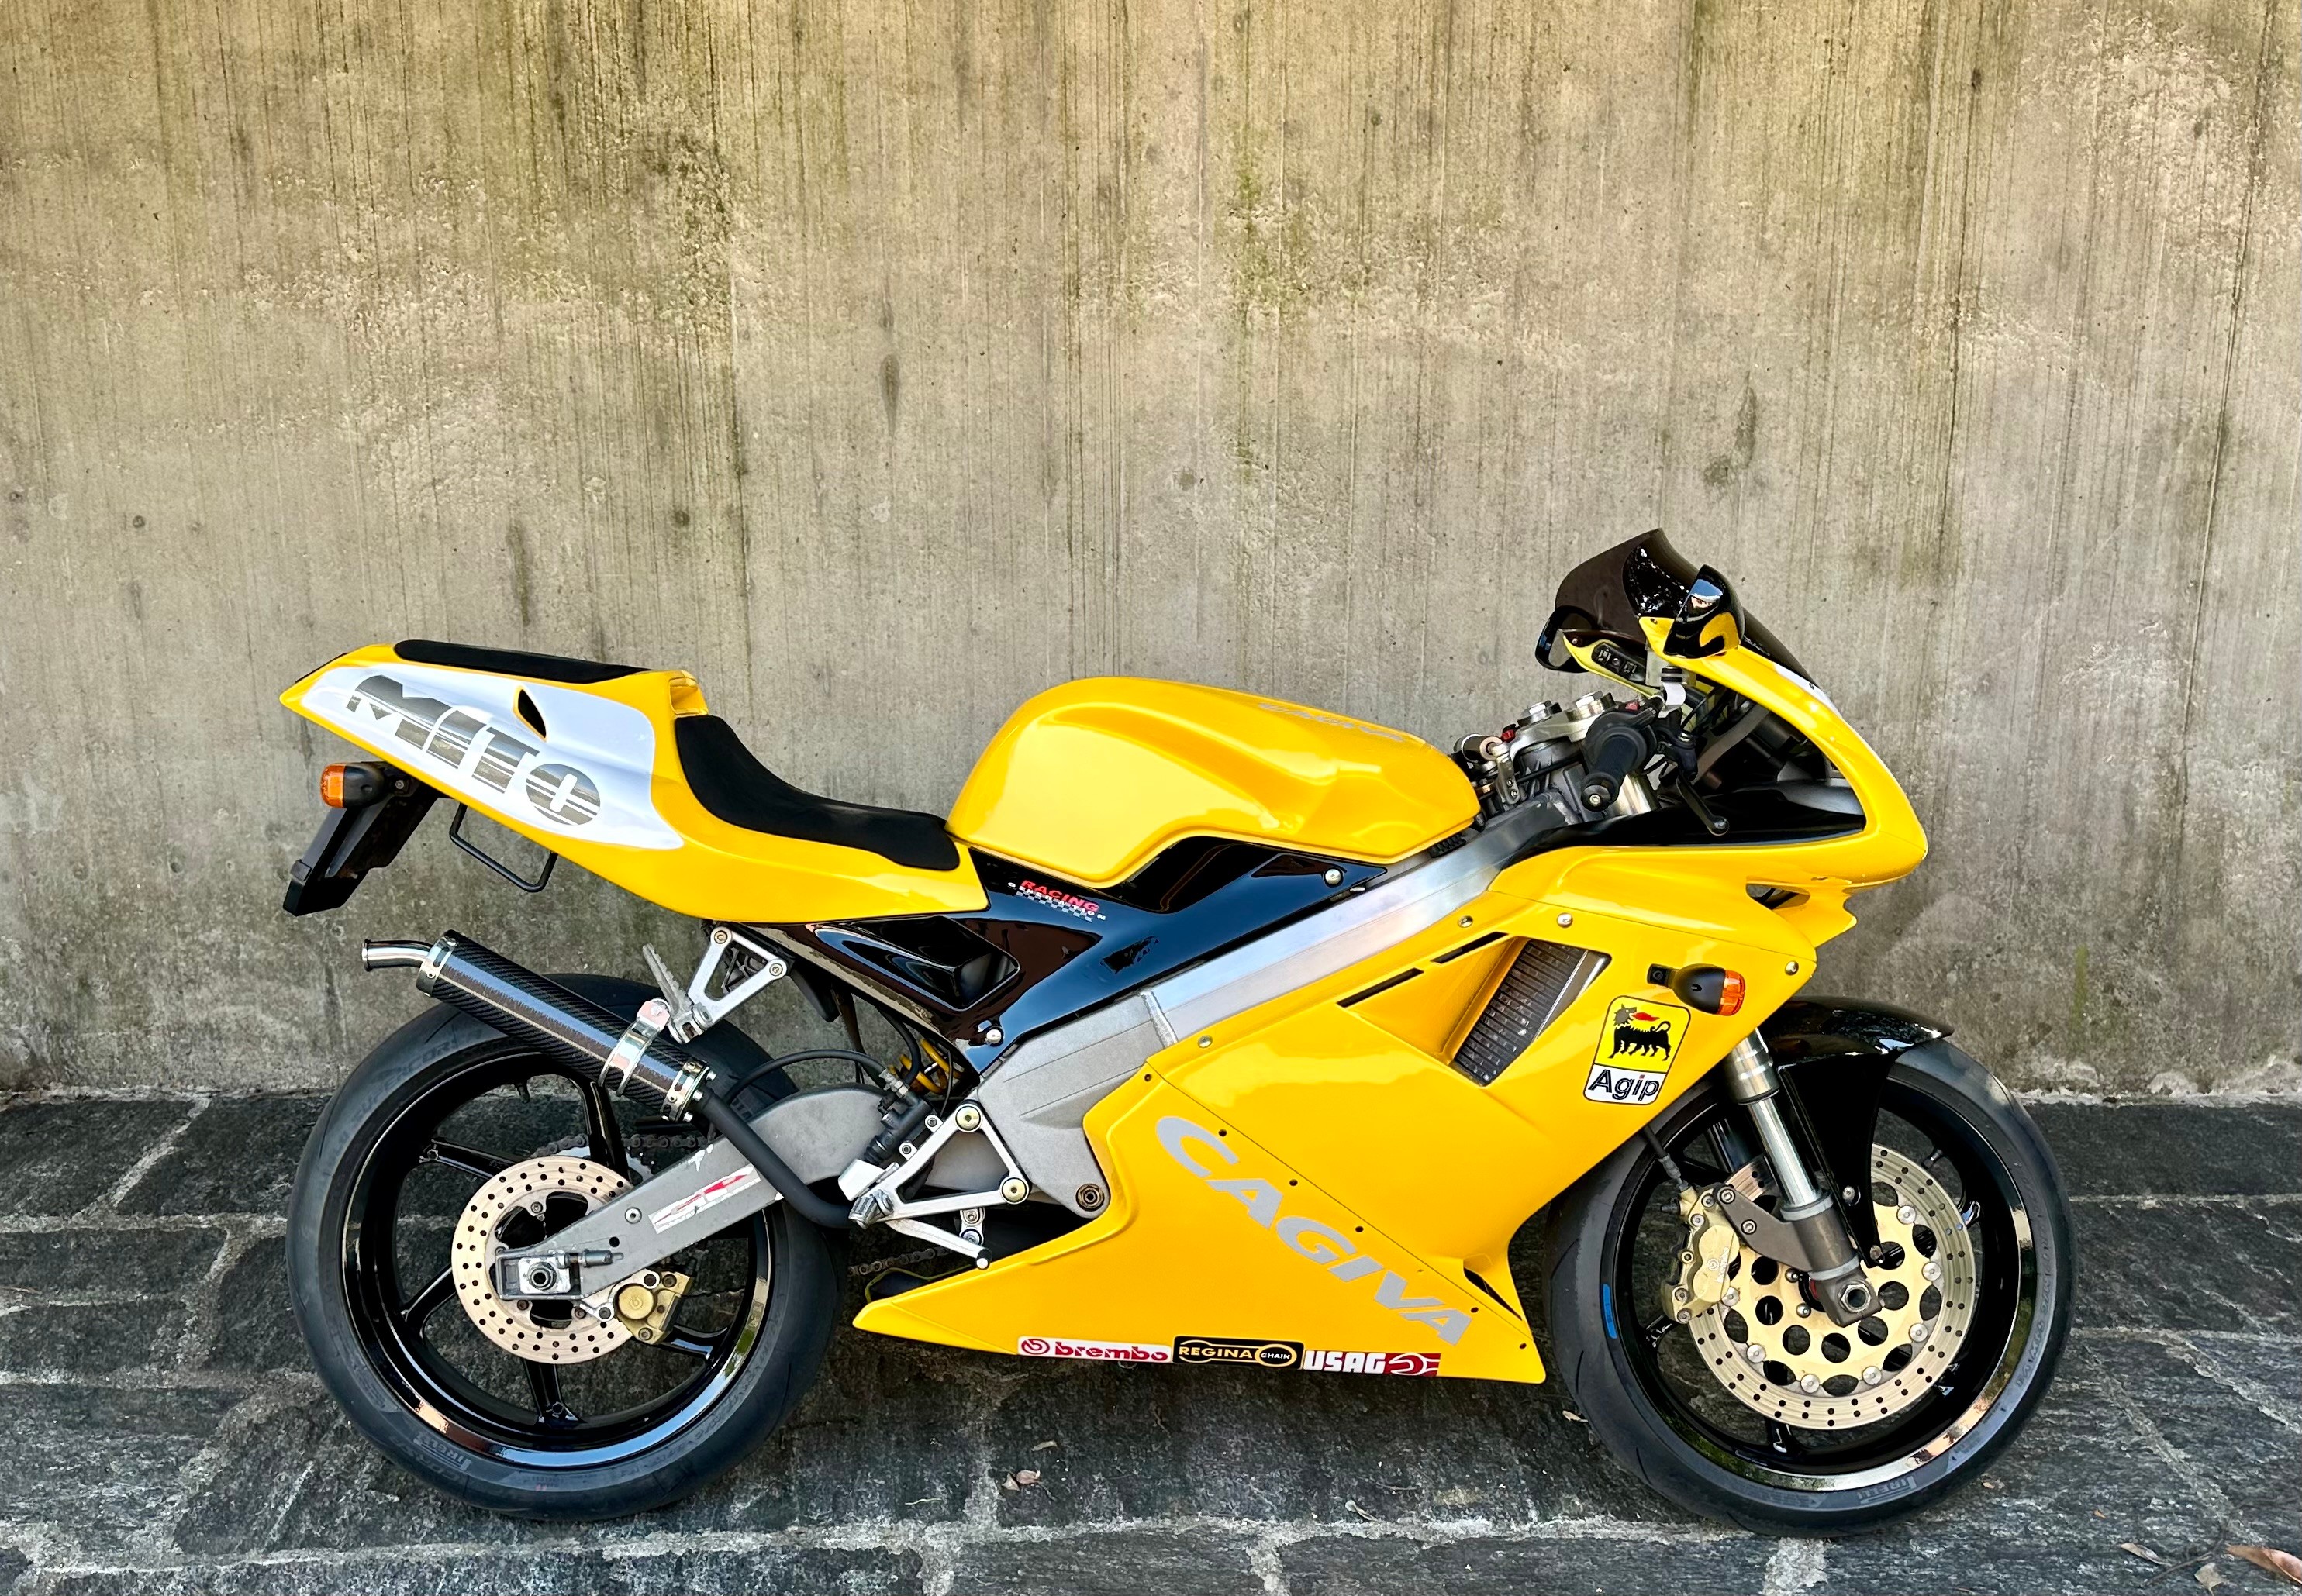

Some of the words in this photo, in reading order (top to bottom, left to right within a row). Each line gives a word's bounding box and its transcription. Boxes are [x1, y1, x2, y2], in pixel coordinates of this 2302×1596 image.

[346, 675, 601, 826] MITO
[1020, 880, 1100, 912] RACING
[1588, 1069, 1660, 1101] Agip
[1156, 1116, 1472, 1346] CAGIVA
[1055, 1341, 1168, 1361] brembo
[1179, 1346, 1253, 1360] REGINA
[1260, 1352, 1292, 1360] CHAIN
[1306, 1350, 1387, 1374] USAG
[1855, 1474, 1918, 1506] PIRELLI
